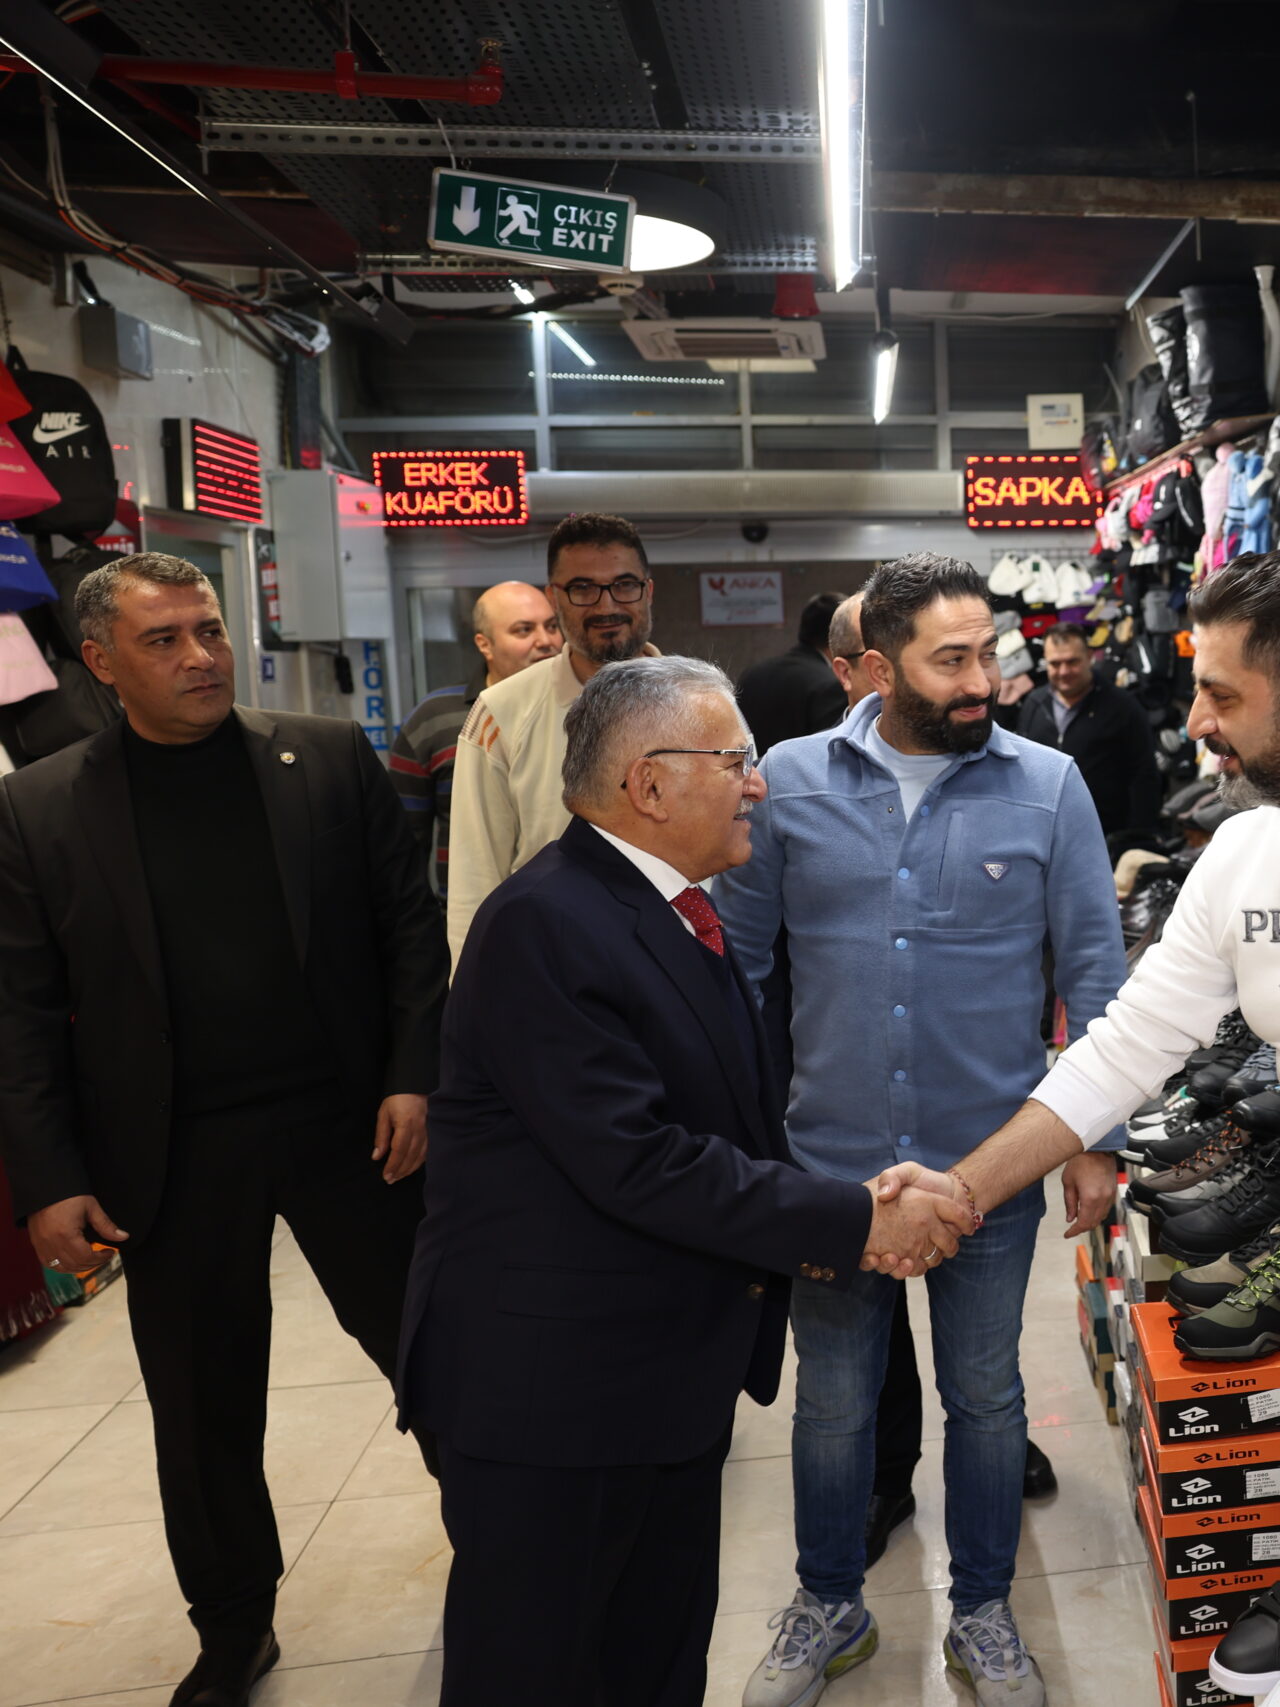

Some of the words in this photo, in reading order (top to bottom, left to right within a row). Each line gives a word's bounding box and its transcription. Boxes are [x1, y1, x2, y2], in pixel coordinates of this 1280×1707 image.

[553, 204, 618, 234] ÇIKIŞ
[552, 227, 614, 253] EXIT
[40, 412, 81, 430] NIKE
[46, 444, 91, 459] AIR
[403, 462, 489, 487] ERKEK
[974, 477, 1091, 506] SAPKA
[385, 486, 514, 515] KUAFÖRÜ
[1212, 1378, 1257, 1390] Lion
[1168, 1424, 1220, 1437] Lion
[1215, 1449, 1260, 1461] Lion
[1171, 1494, 1222, 1508] Lion
[1217, 1513, 1261, 1525] Lion
[1176, 1560, 1226, 1574] Lion
[1221, 1573, 1264, 1586] Lion
[1179, 1621, 1229, 1635] Lion
[1186, 1694, 1236, 1707] Lion
